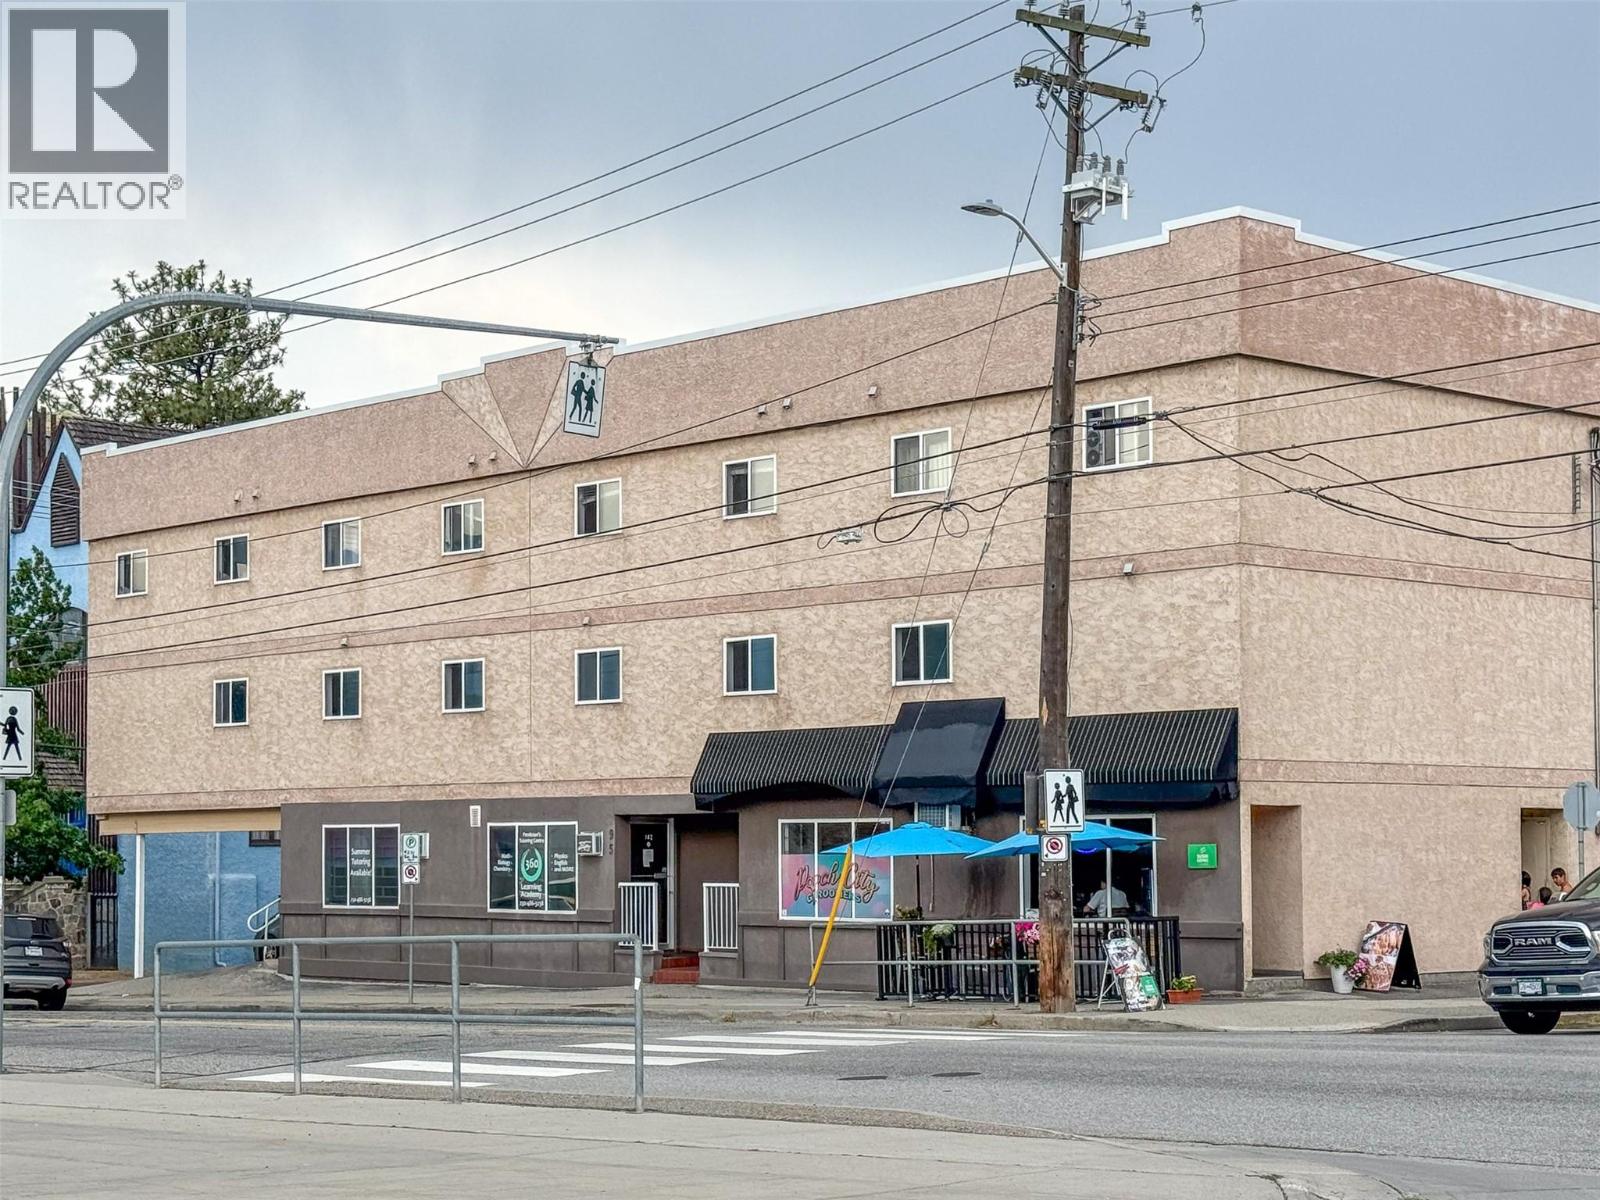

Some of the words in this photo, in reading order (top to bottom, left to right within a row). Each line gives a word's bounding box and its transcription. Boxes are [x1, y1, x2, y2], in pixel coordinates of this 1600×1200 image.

[351, 858, 370, 867] Tutoring
[525, 858, 538, 870] 360
[520, 884, 542, 892] Learning
[844, 862, 880, 904] City
[806, 889, 861, 904] GROOERS
[1514, 938, 1552, 946] RAM
